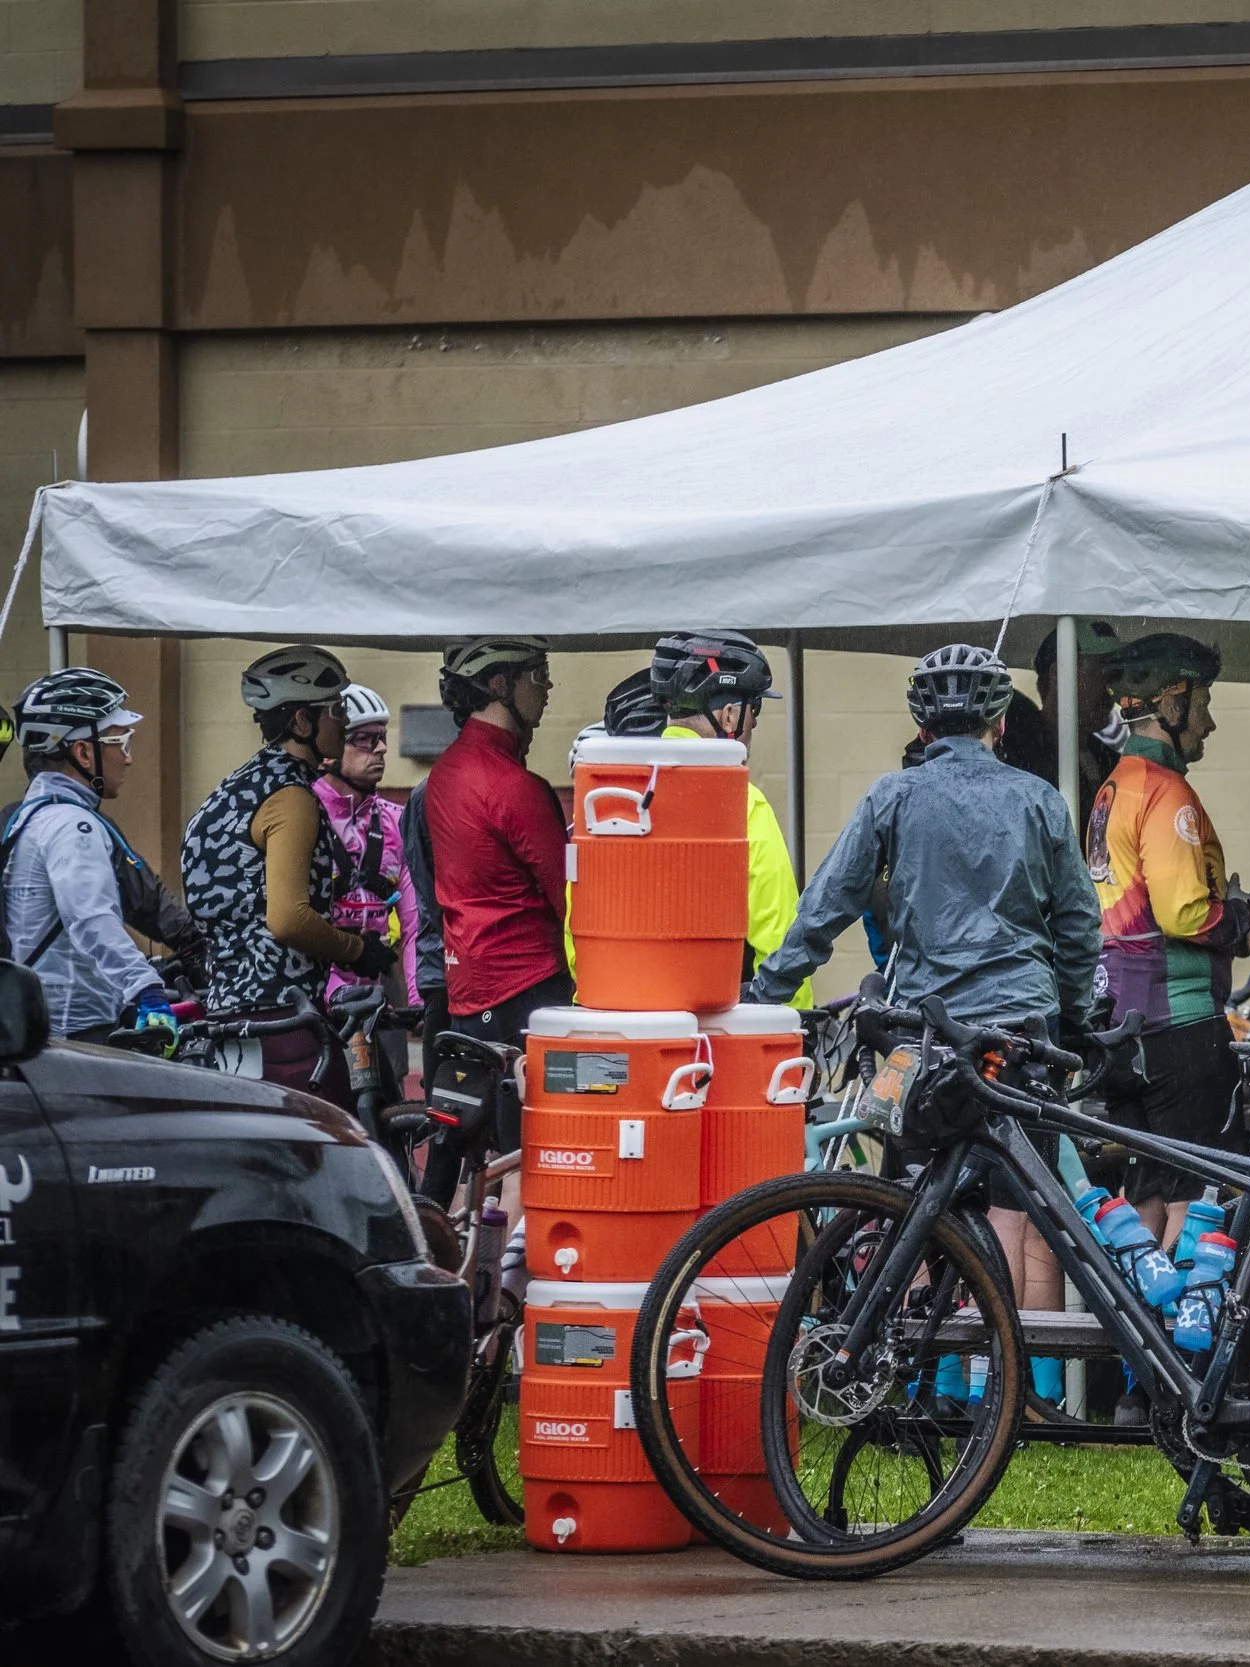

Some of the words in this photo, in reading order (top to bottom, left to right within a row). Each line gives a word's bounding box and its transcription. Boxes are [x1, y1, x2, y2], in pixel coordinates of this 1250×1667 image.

[540, 1150, 593, 1165] IGLOO
[88, 1165, 156, 1184] LIMITED
[535, 1421, 587, 1436] IGLOO
